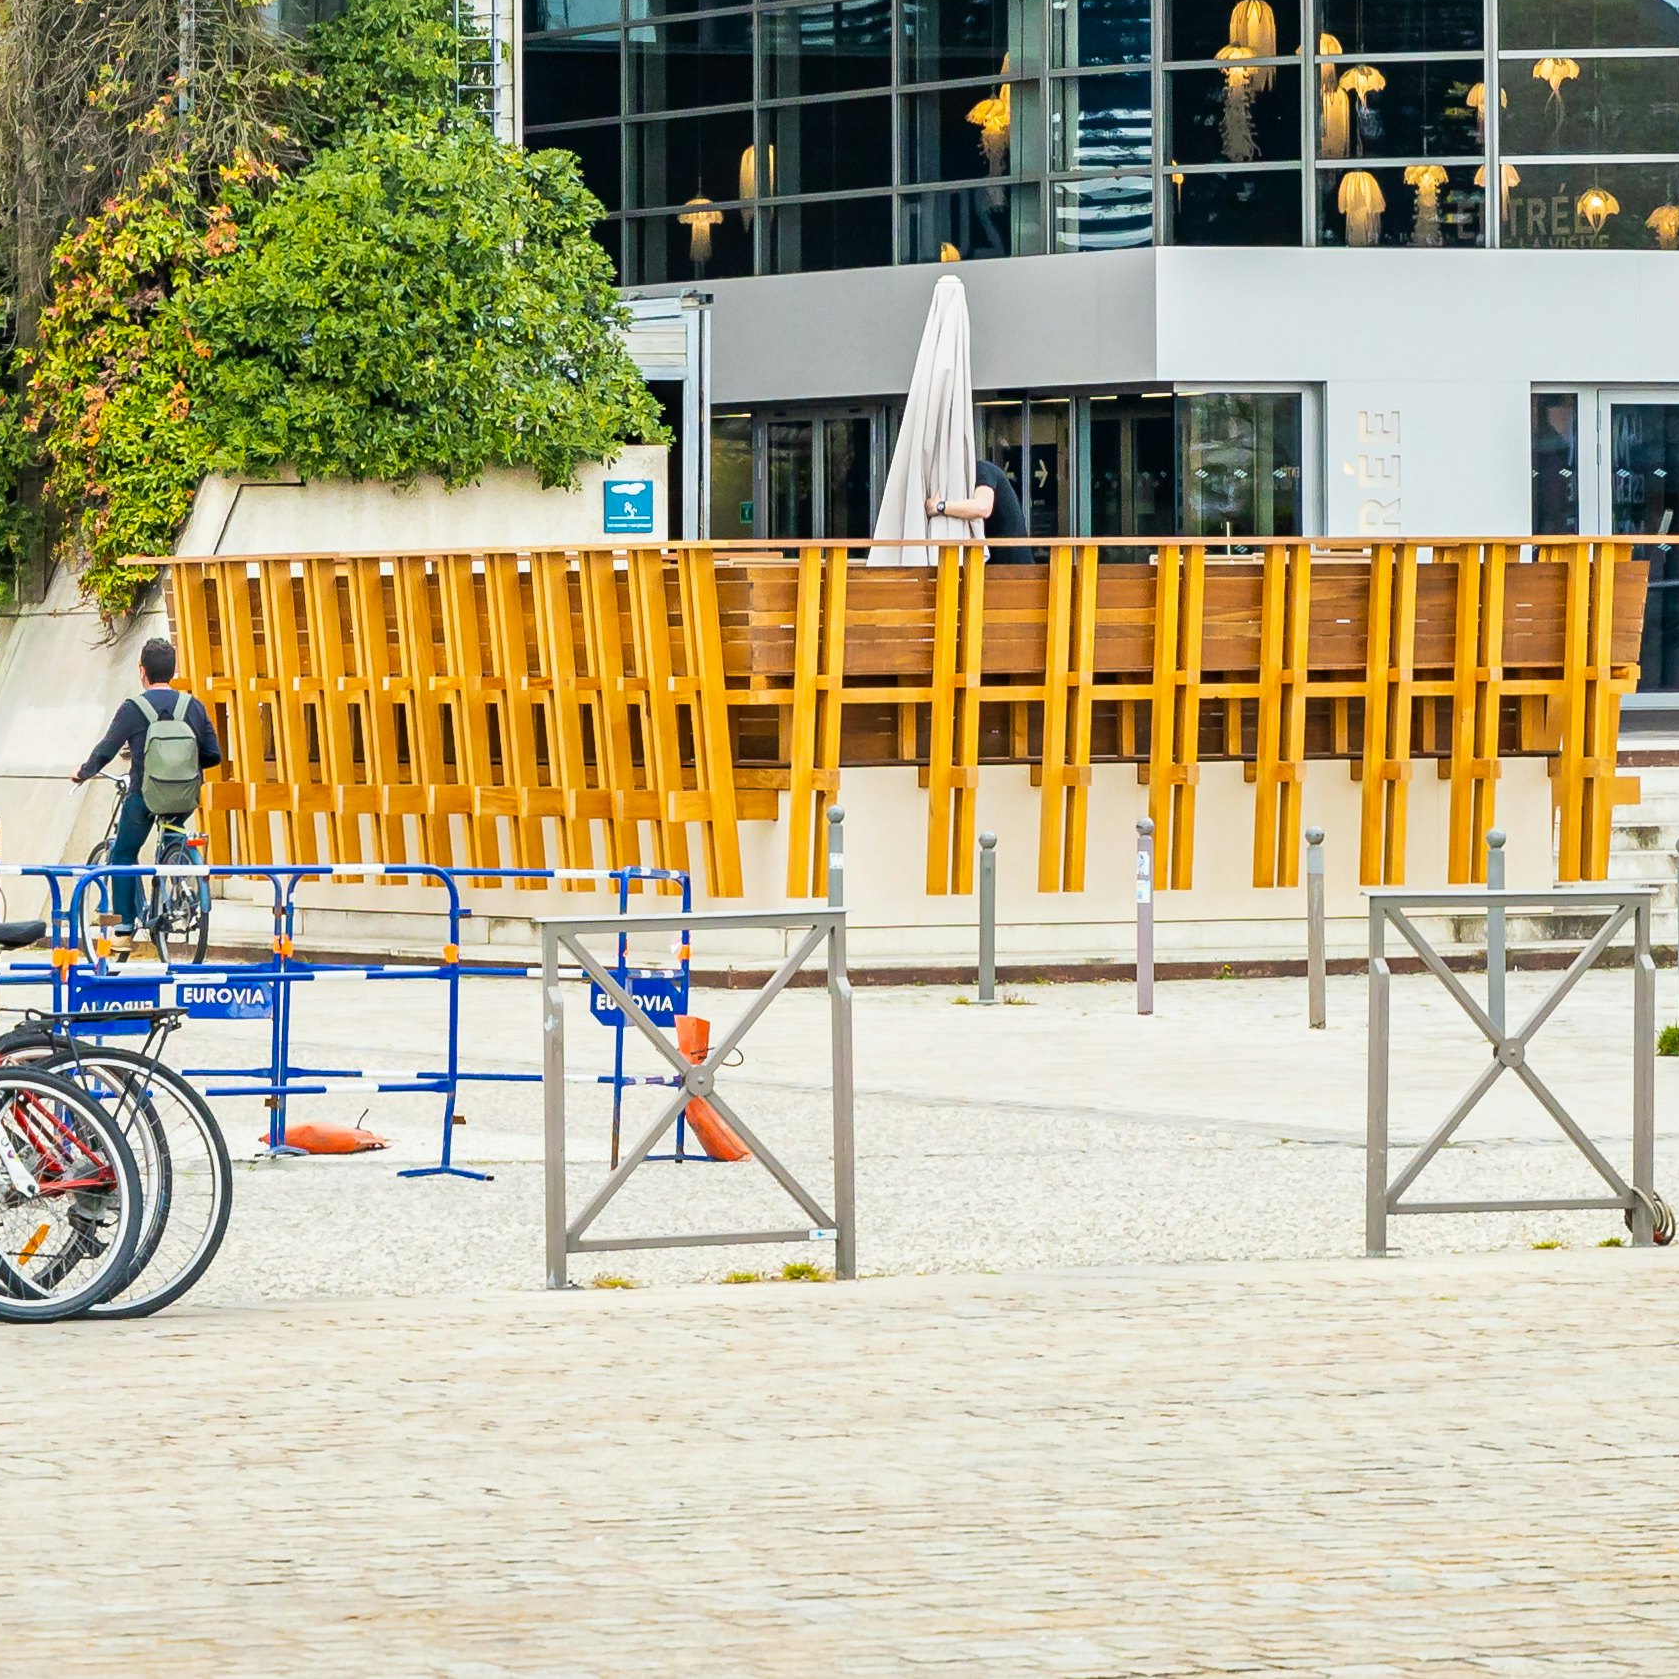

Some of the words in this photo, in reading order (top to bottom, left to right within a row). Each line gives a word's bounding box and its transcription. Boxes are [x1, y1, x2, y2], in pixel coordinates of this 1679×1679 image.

[1457, 182, 1597, 239] ETRÉE
[183, 986, 265, 1005] EUROVIA
[596, 993, 674, 1012] EUOVIA
